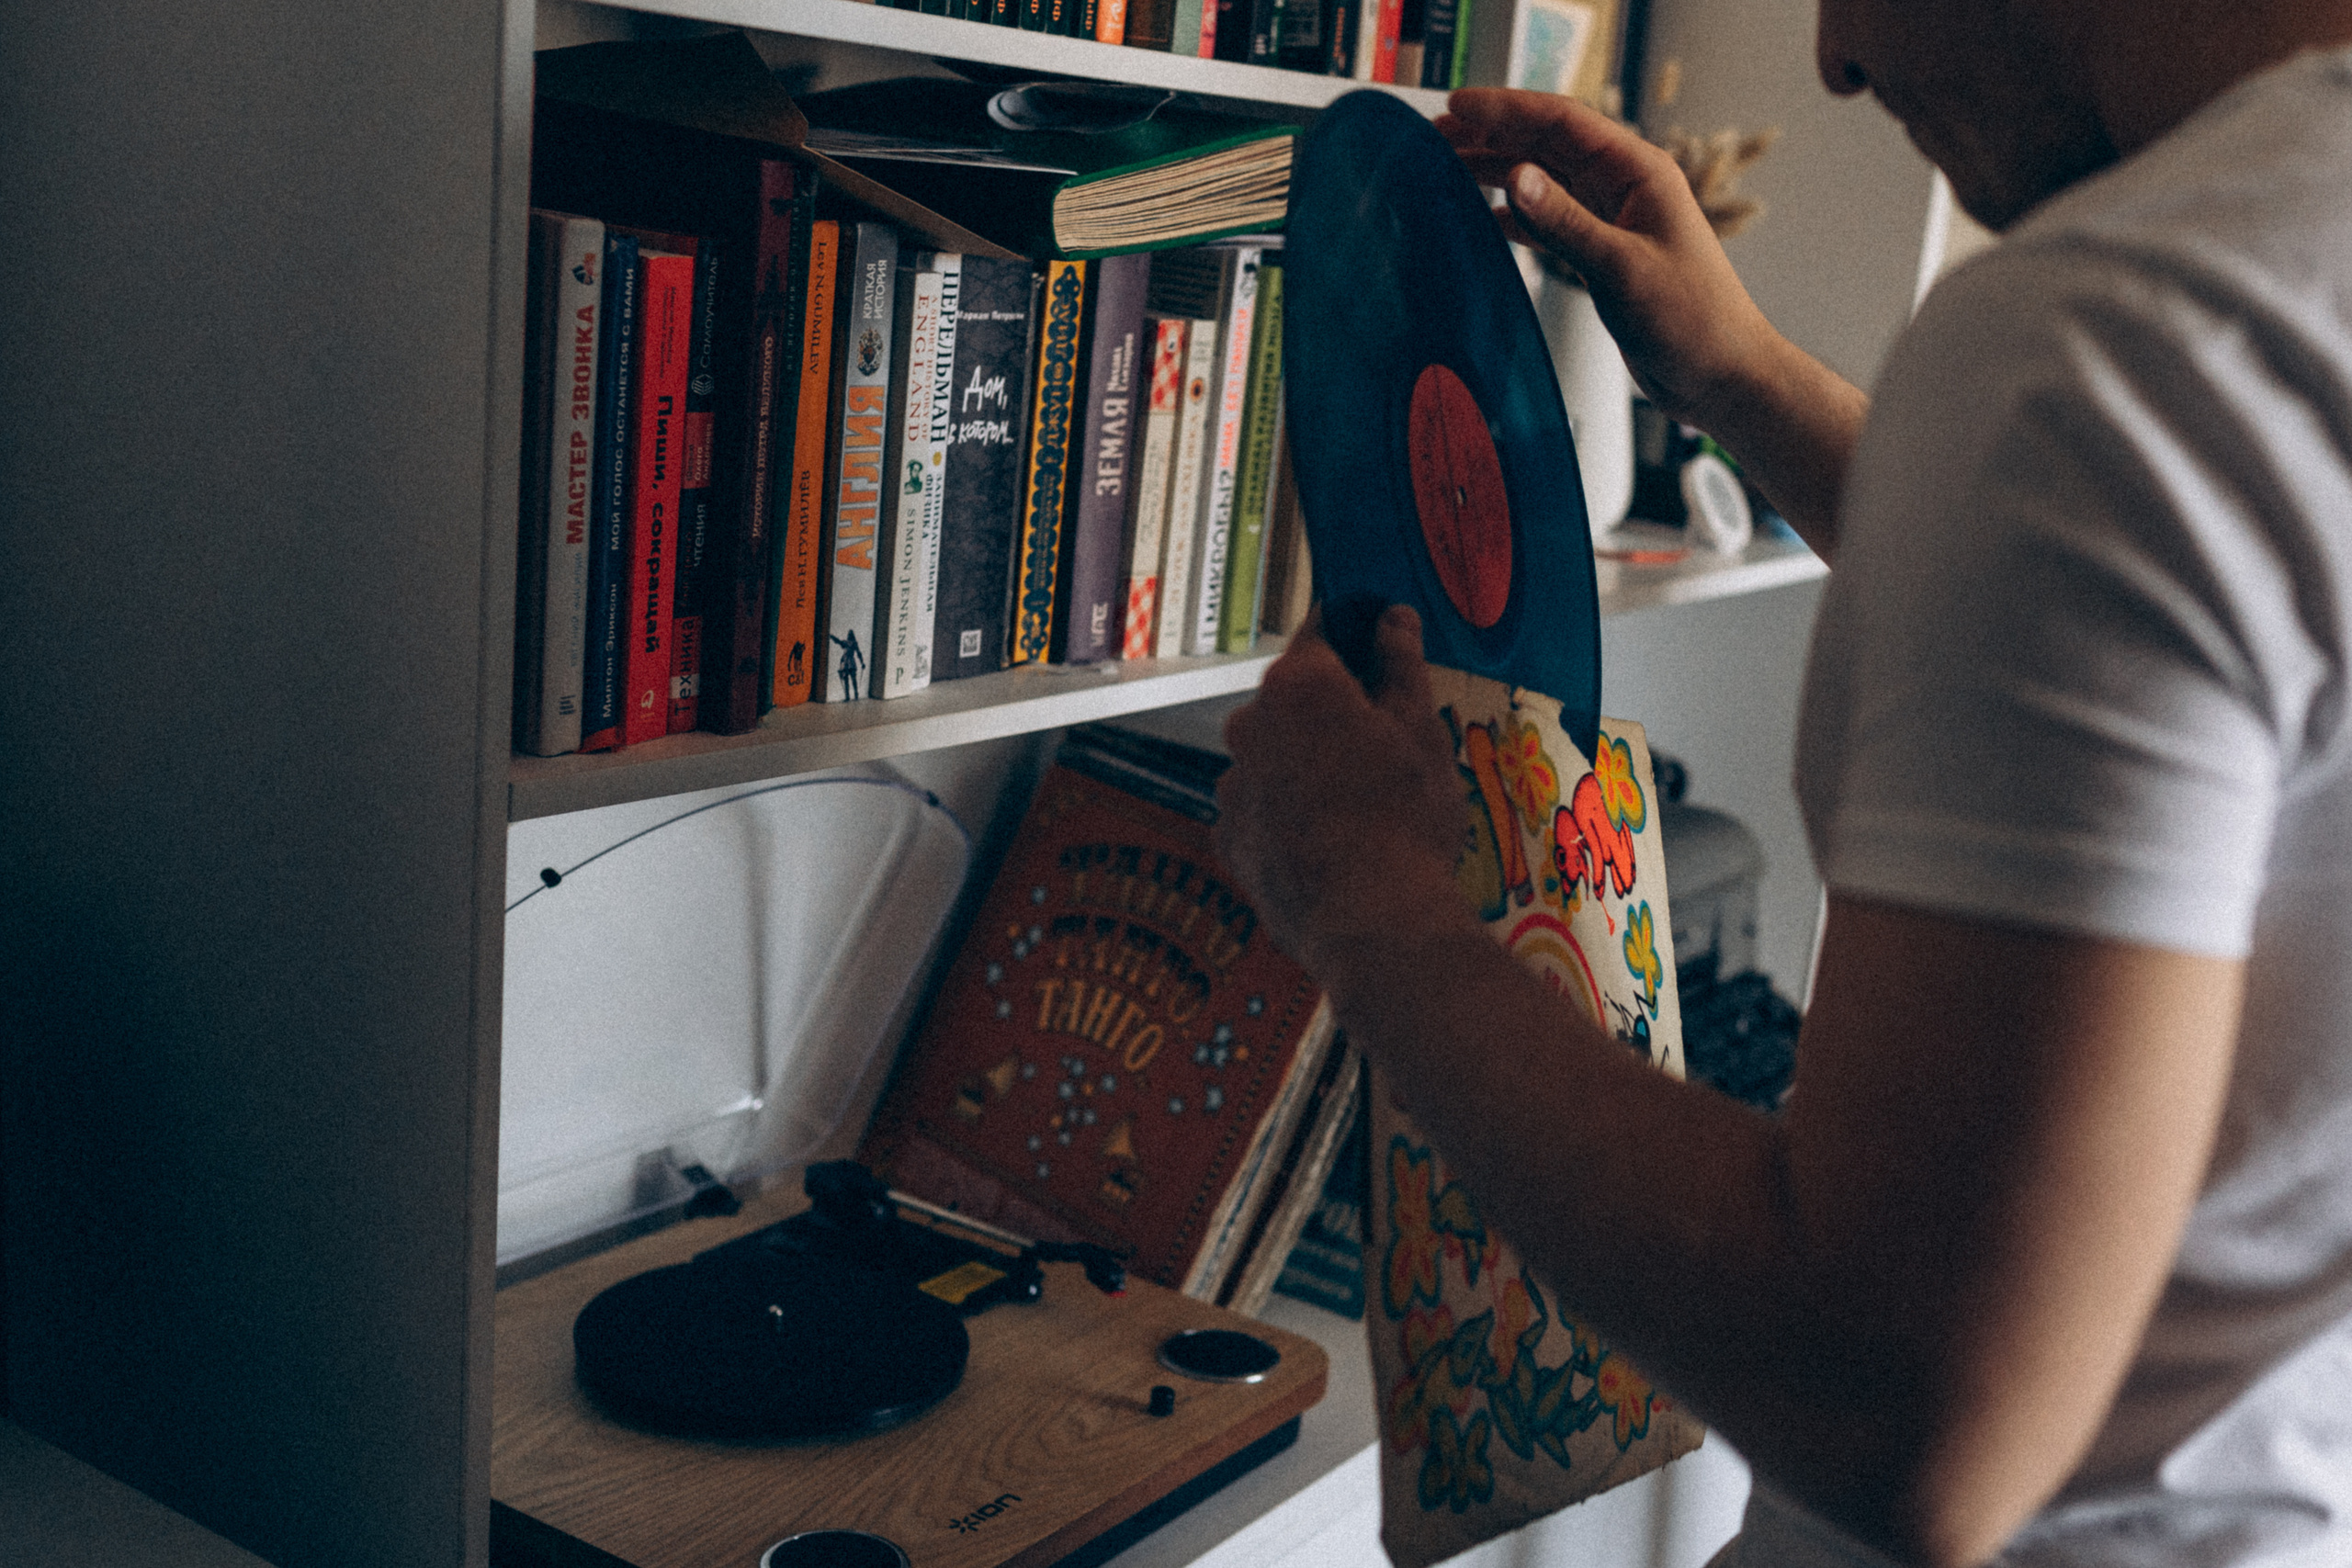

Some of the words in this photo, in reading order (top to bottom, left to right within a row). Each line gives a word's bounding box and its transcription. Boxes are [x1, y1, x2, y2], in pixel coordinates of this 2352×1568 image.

[621, 324, 631, 336] С
[622, 268, 635, 318] ВАМИ
[698, 257, 719, 368] Самоучитель
[862, 263, 876, 319] КРАТКАЯ
[874, 260, 888, 319] ИСТОРИЯ
[571, 304, 595, 422] ЗВОНКА
[615, 343, 630, 443] ОСТАНЕТСЯ
[908, 294, 929, 443] ENGLAND
[930, 272, 959, 444] ПЕРЕЛЬМАН
[564, 431, 588, 547] МАСТЕР
[612, 448, 625, 505] ГОЛОС
[651, 395, 673, 491] Пиши,
[836, 385, 886, 570] АНГЛИЯ
[1095, 397, 1129, 496] ЗЕМЛЯ
[610, 512, 623, 550] МОЙ
[644, 502, 664, 654] сокращай
[692, 503, 707, 568] чтения
[902, 508, 917, 571] SIMON
[925, 473, 943, 613] ЗАНИМАТЕЛЬНАЯ
[605, 583, 618, 651] Эриксон
[795, 580, 806, 609] Лев
[896, 576, 911, 657] JENKINS
[601, 657, 614, 718] Милтон
[674, 619, 695, 716] Техника
[1035, 977, 1164, 1072] ТАНГО
